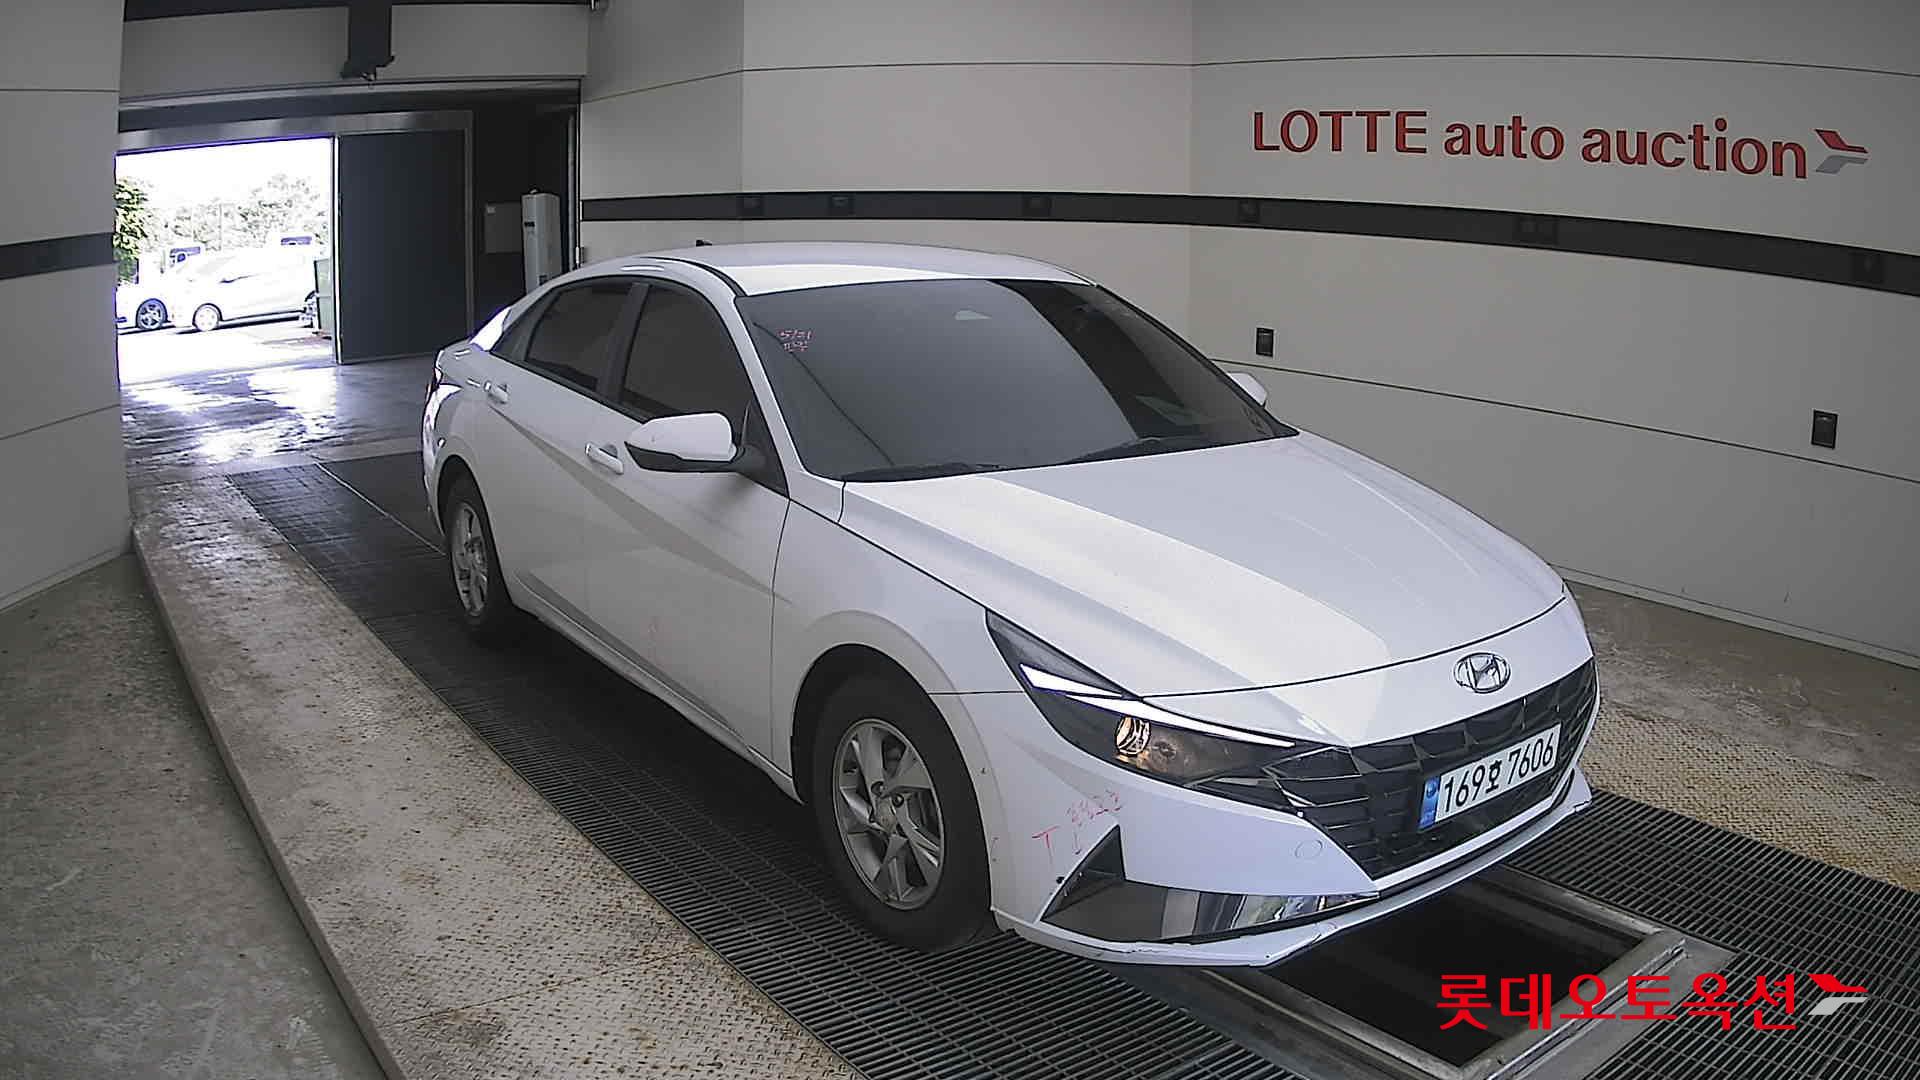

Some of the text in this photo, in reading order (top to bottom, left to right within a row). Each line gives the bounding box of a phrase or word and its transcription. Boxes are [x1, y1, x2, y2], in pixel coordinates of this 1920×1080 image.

[1253, 111, 1808, 179] LOTTE auto auction
[1508, 733, 1554, 785] 7606
